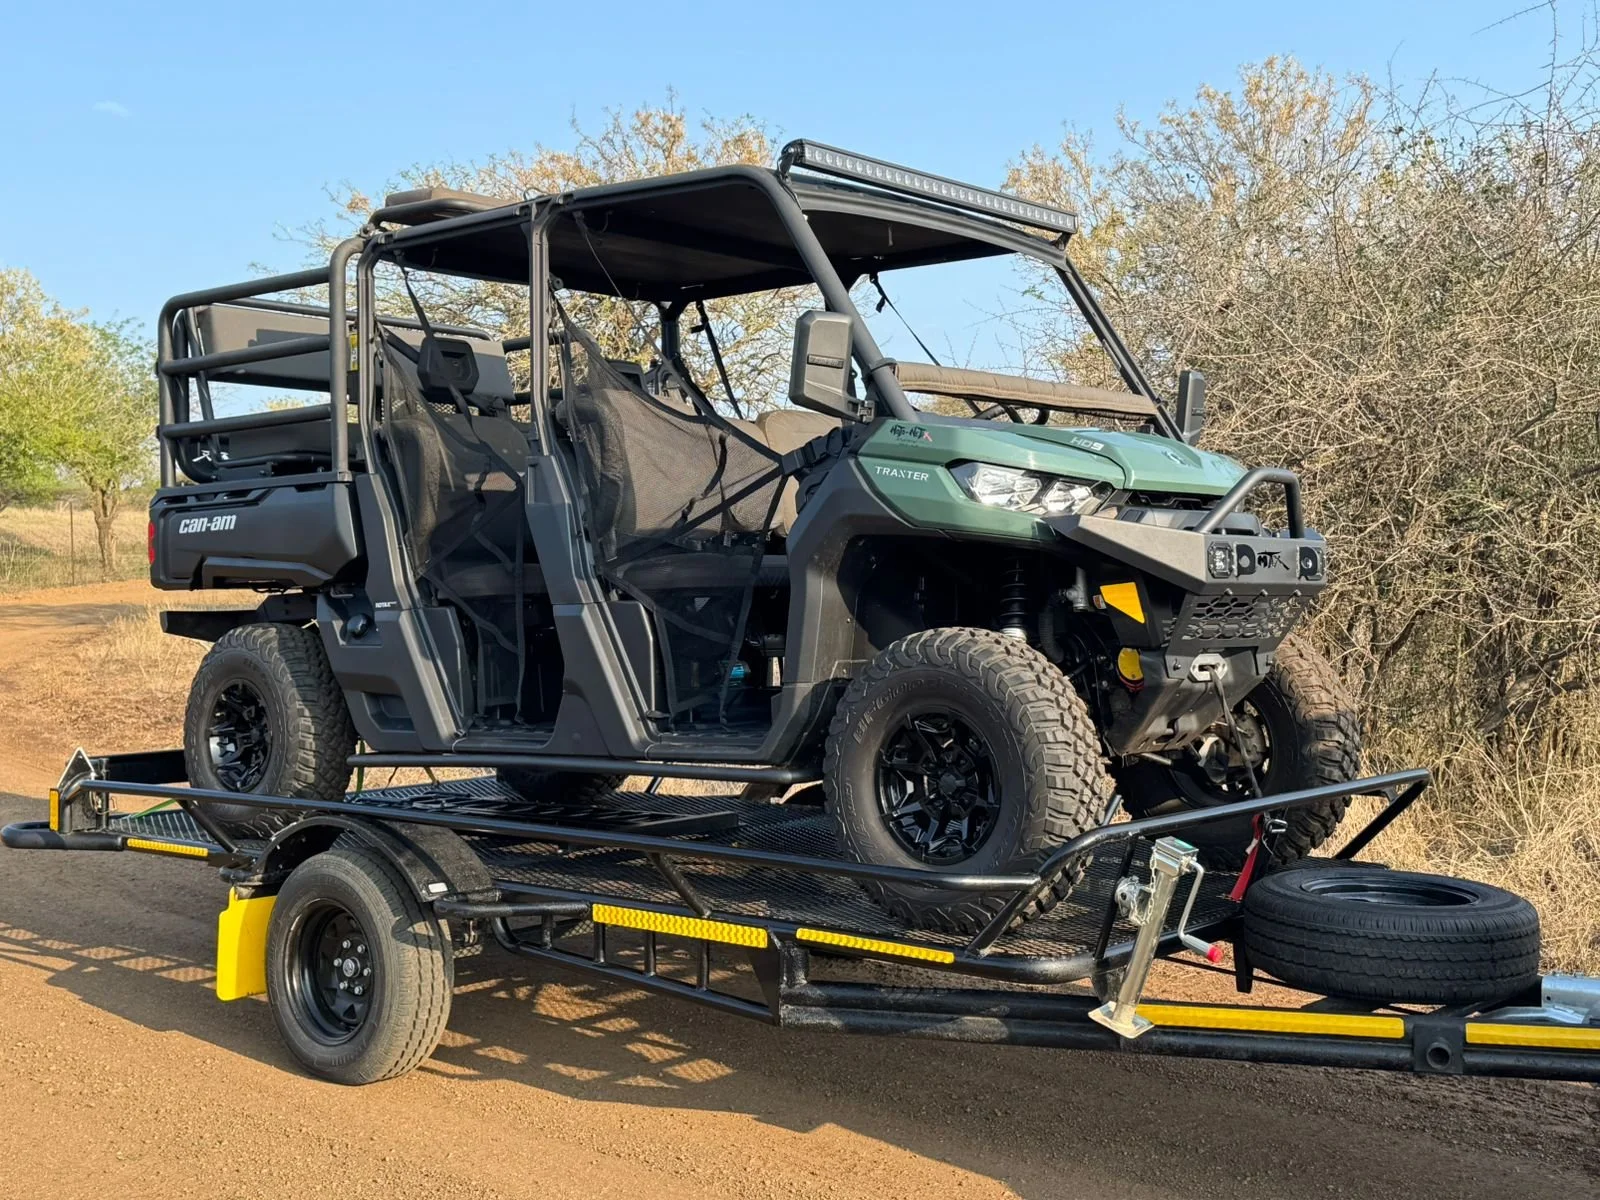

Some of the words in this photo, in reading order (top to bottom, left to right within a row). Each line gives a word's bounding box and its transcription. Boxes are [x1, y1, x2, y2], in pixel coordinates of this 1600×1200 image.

[1070, 436, 1105, 451] HD9
[875, 465, 929, 482] TRAXTER
[178, 514, 237, 534] can-am
